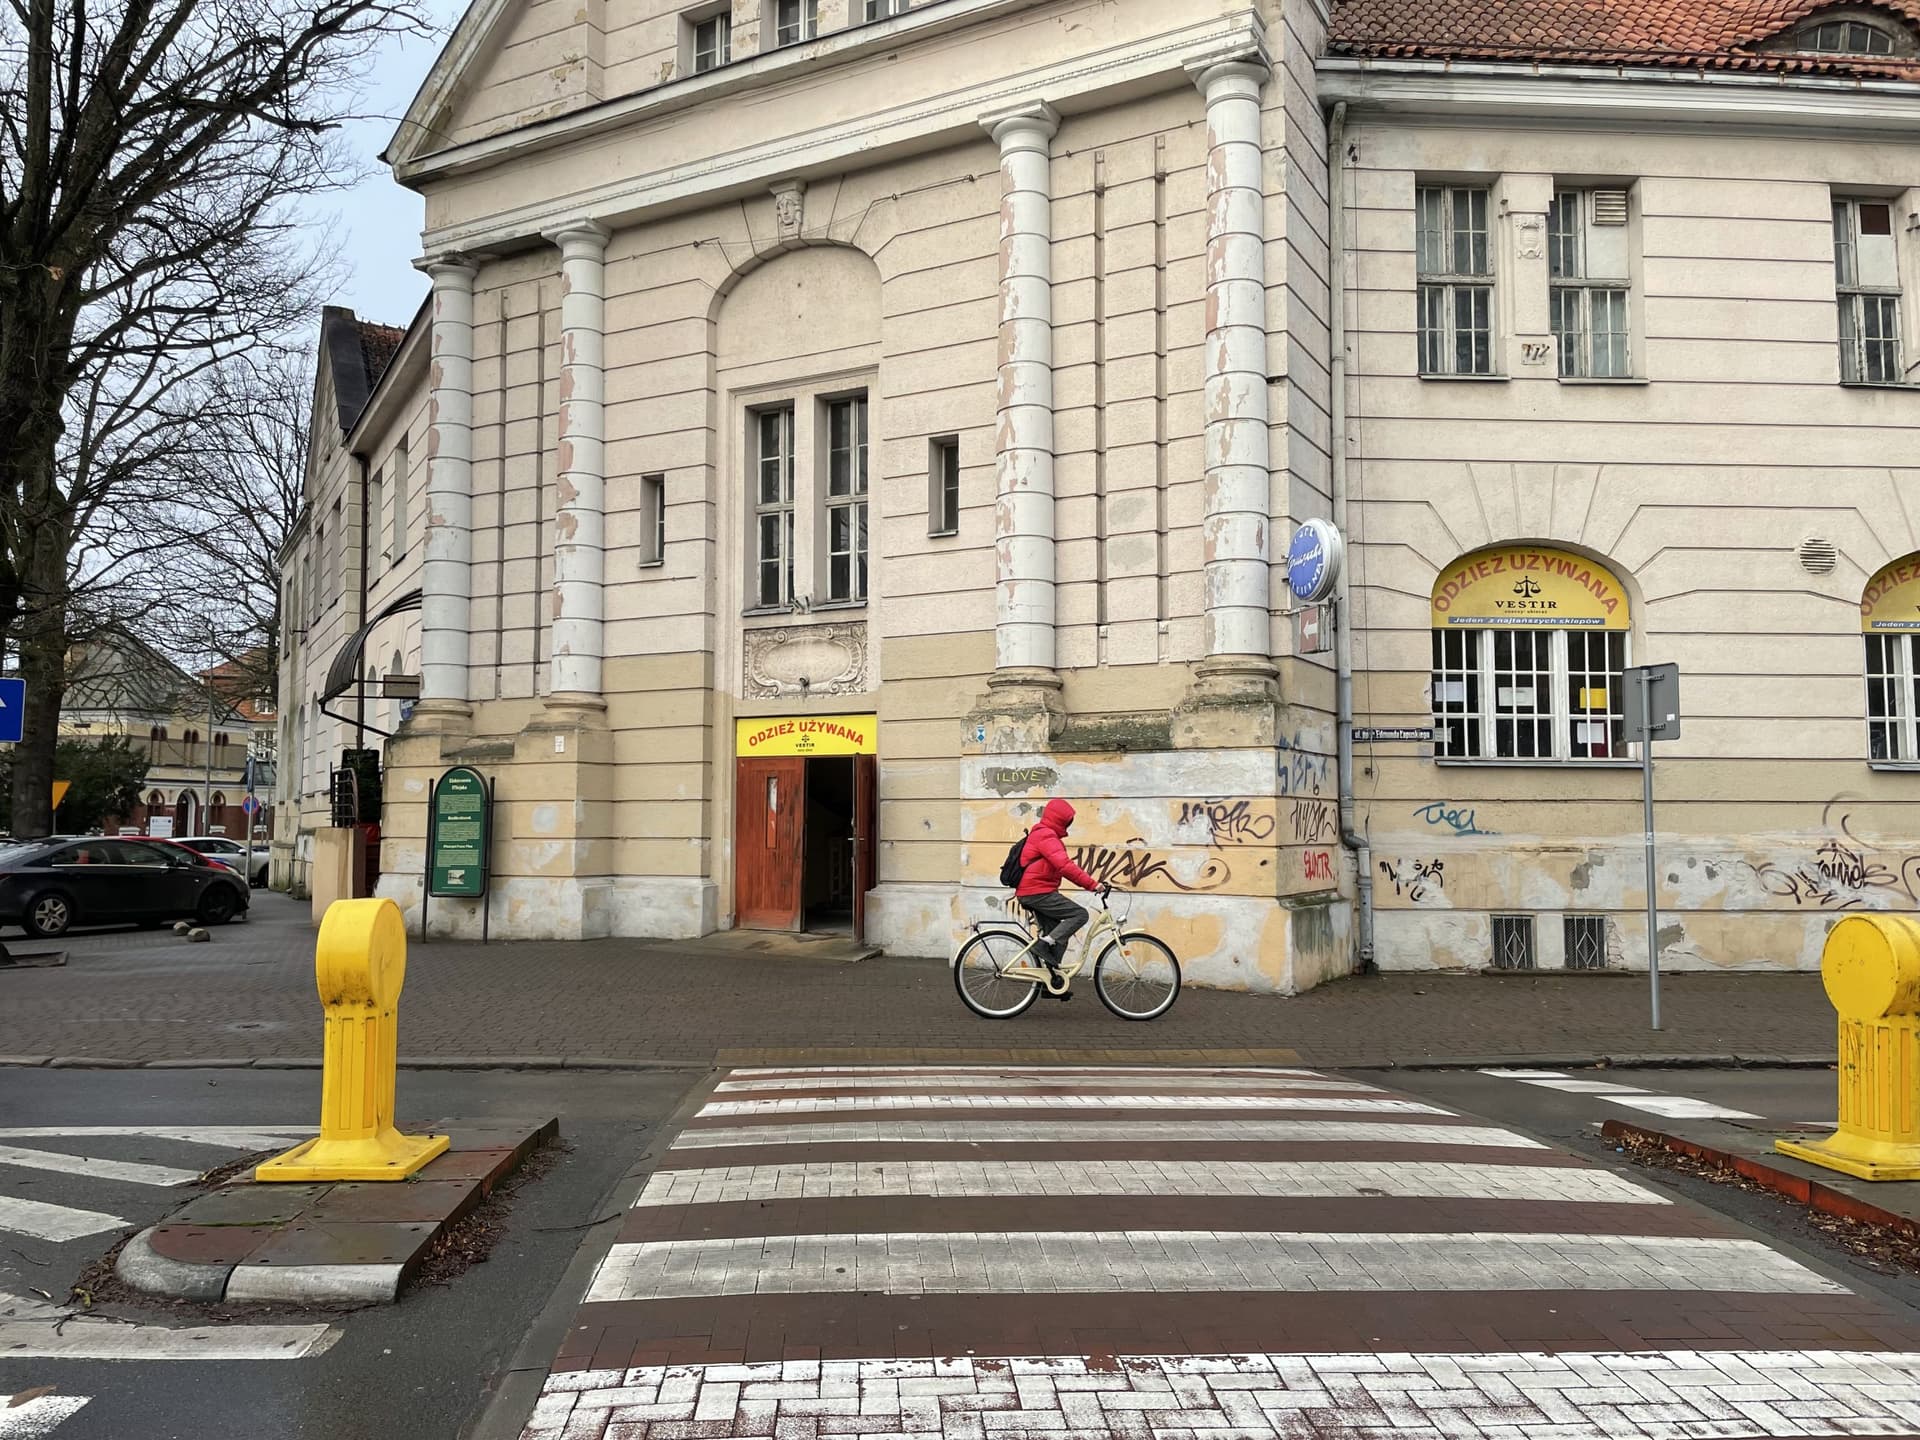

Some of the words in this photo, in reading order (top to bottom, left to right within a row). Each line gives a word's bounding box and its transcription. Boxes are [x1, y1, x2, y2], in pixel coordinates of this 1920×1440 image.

[1434, 553, 1507, 613] ODZIEŻ
[1510, 550, 1619, 614] UŻYWANA
[1495, 600, 1557, 609] VESTIR
[748, 720, 796, 747] ODZIEŻ
[799, 720, 864, 746] UŻYWANA
